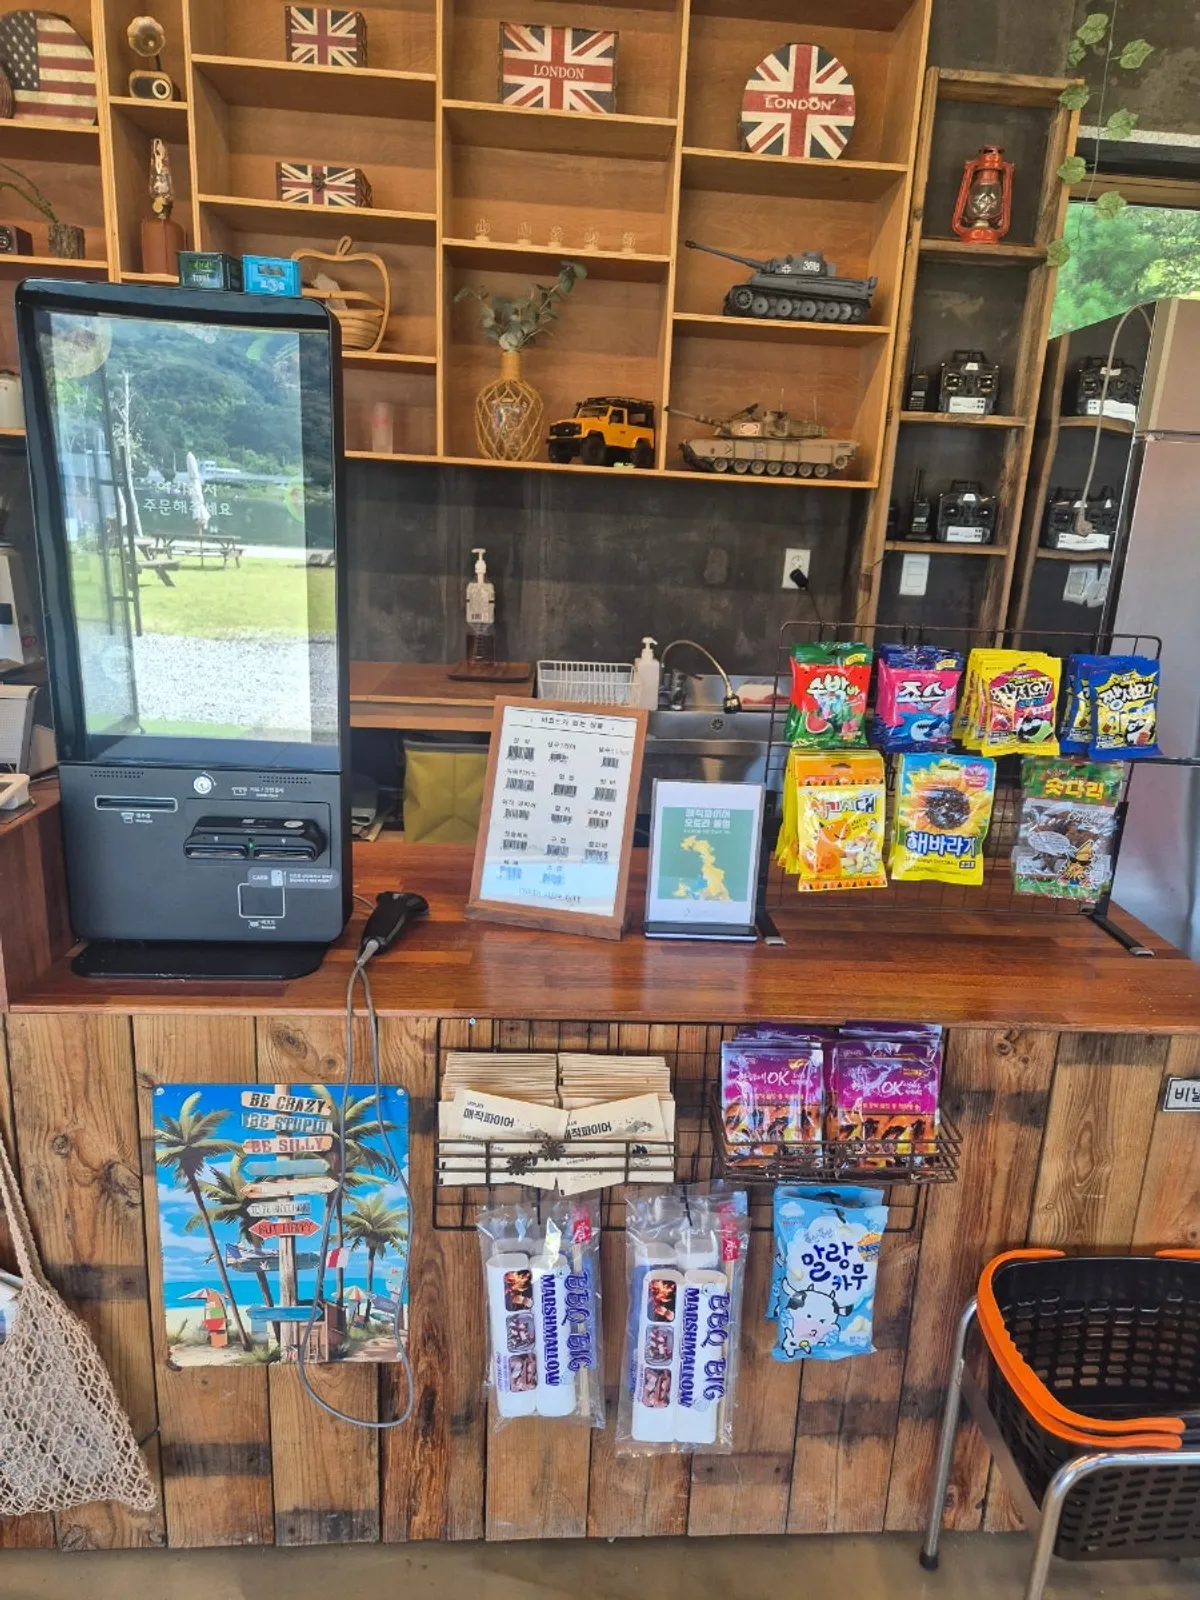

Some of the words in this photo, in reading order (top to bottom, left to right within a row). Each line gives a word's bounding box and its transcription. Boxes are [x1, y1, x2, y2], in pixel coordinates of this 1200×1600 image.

[533, 64, 585, 79] LONDON
[763, 94, 836, 111] LONDON
[905, 831, 976, 858] 해바라기
[767, 1070, 790, 1086] OK
[881, 1081, 904, 1096] OK
[250, 1092, 270, 1108] BE
[276, 1095, 326, 1113] CRAZY
[248, 1113, 269, 1129] BE
[275, 1115, 327, 1134] STUPID
[463, 1108, 515, 1128] 매직파이어
[251, 1139, 271, 1153] BE
[279, 1137, 324, 1152] SILLY
[832, 1263, 868, 1291] 카우
[540, 1274, 560, 1387] MARSHMALLOW
[701, 1292, 731, 1348] BBQ
[567, 1333, 592, 1371] BIG
[678, 1287, 700, 1408] MARSHMALLOW
[703, 1357, 728, 1401] BIG
